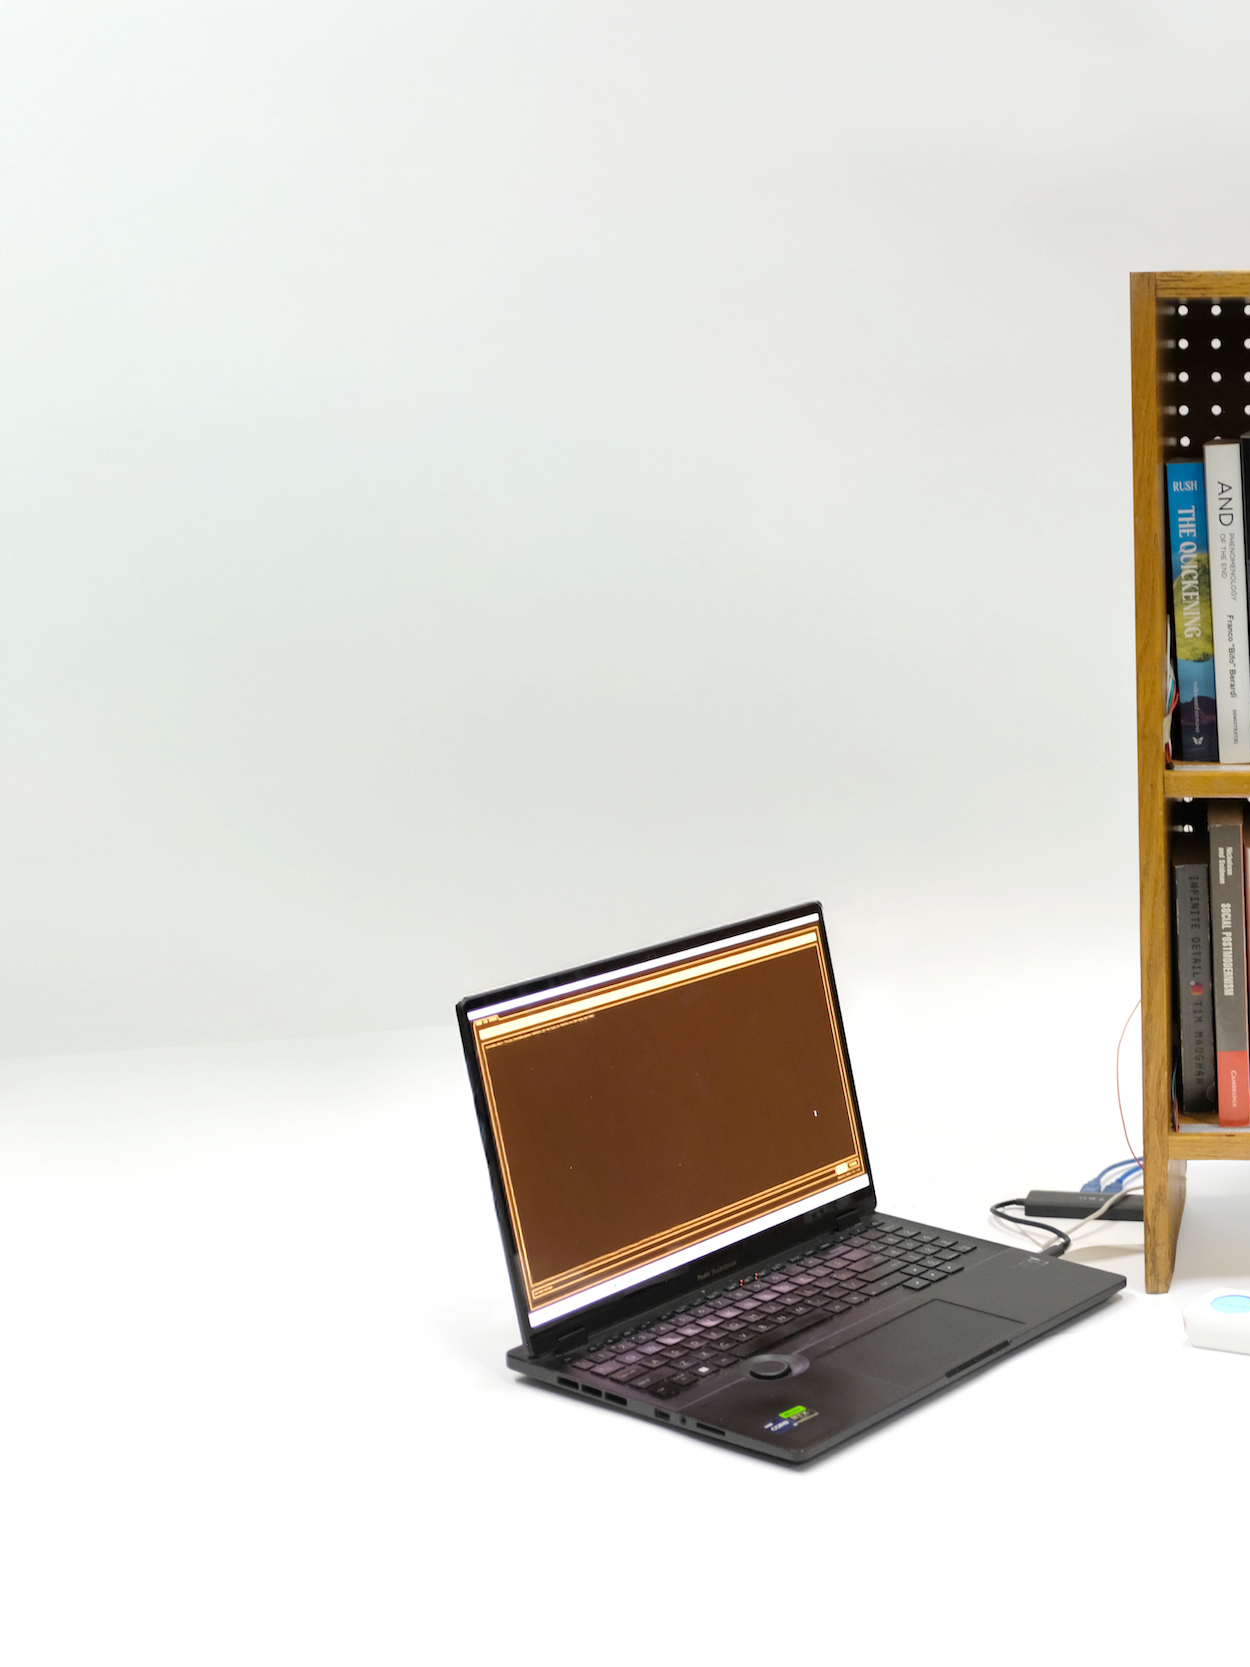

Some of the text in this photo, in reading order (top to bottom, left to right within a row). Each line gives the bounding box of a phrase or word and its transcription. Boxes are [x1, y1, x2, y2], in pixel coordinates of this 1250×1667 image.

[1173, 480, 1198, 492] RUSH
[1217, 481, 1234, 527] AND
[1220, 533, 1226, 544] OF
[1178, 505, 1202, 638] THE QUICKENING
[1229, 533, 1237, 601] PHENOMENOLOGY
[1227, 615, 1235, 642] Franco
[1229, 669, 1238, 698] Berardi
[1189, 876, 1201, 977] INFINITE DETAIL
[1220, 903, 1235, 996] SOCIAL POSTMODERNISM
